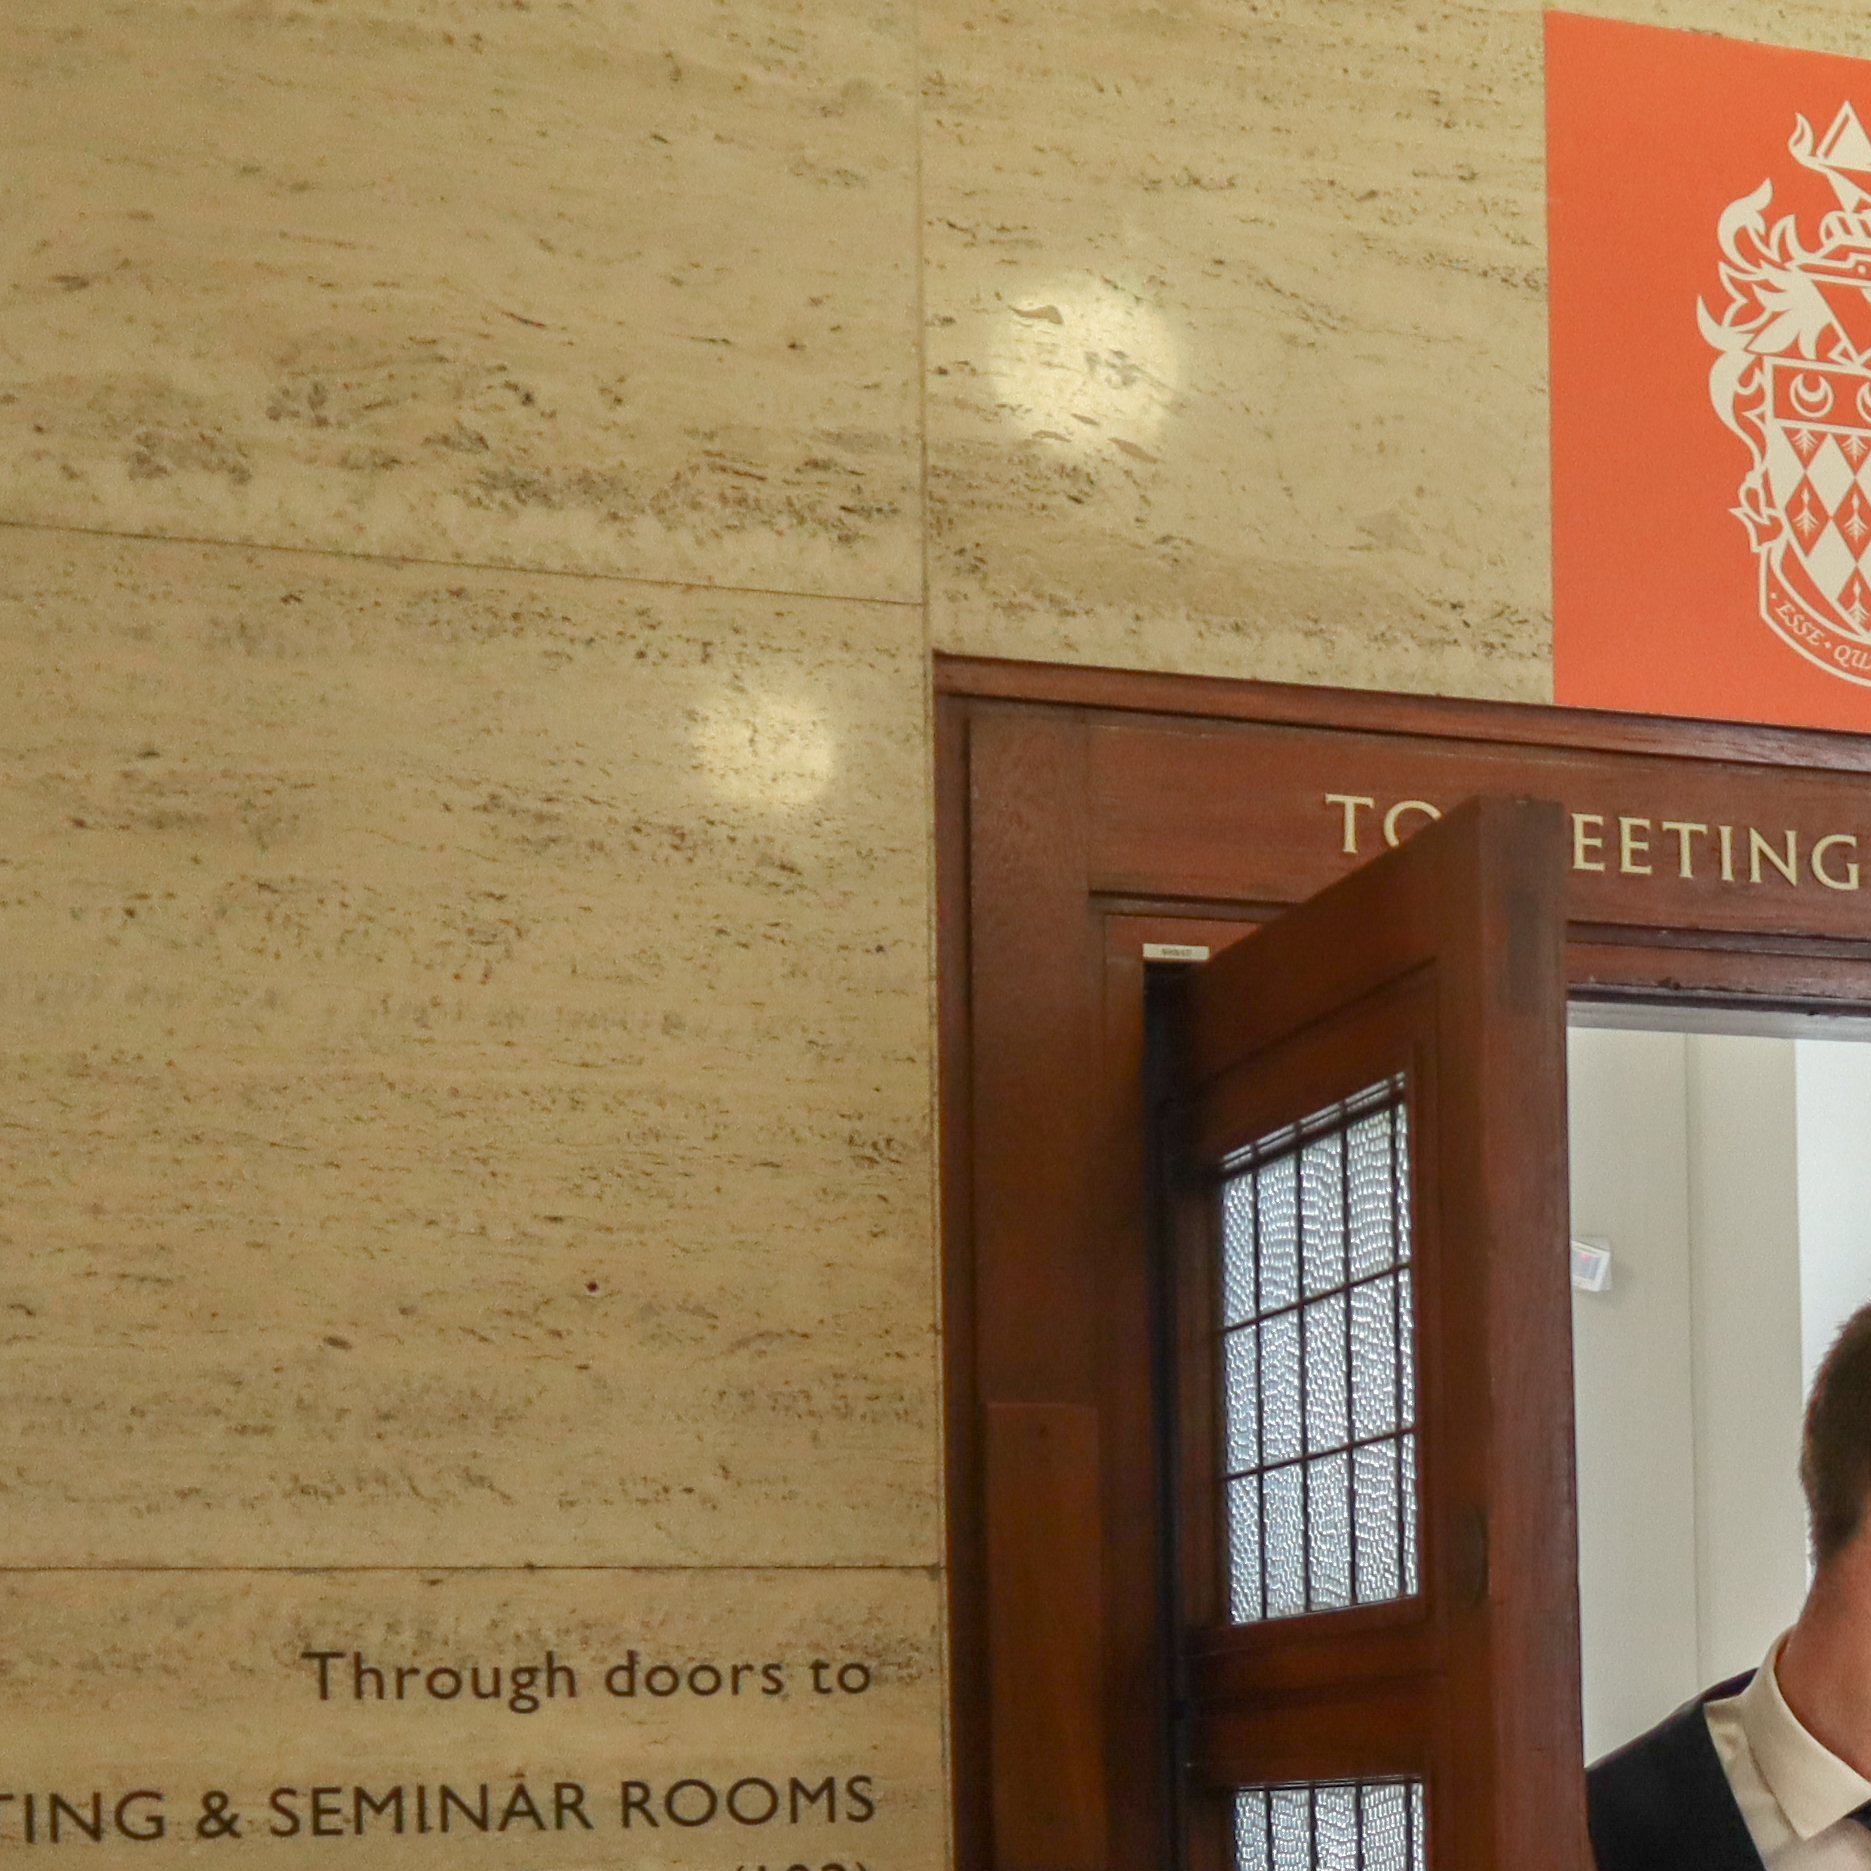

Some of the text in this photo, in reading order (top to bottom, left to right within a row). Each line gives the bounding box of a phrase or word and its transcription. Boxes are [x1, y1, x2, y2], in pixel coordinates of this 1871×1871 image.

[1774, 601, 1825, 647] ESSE
[1571, 813, 1861, 892] EETING
[303, 1650, 876, 1714] Through doors to
[196, 1790, 242, 1840] &
[270, 1781, 594, 1838] SEMINAR
[620, 1774, 877, 1829] ROOMS
